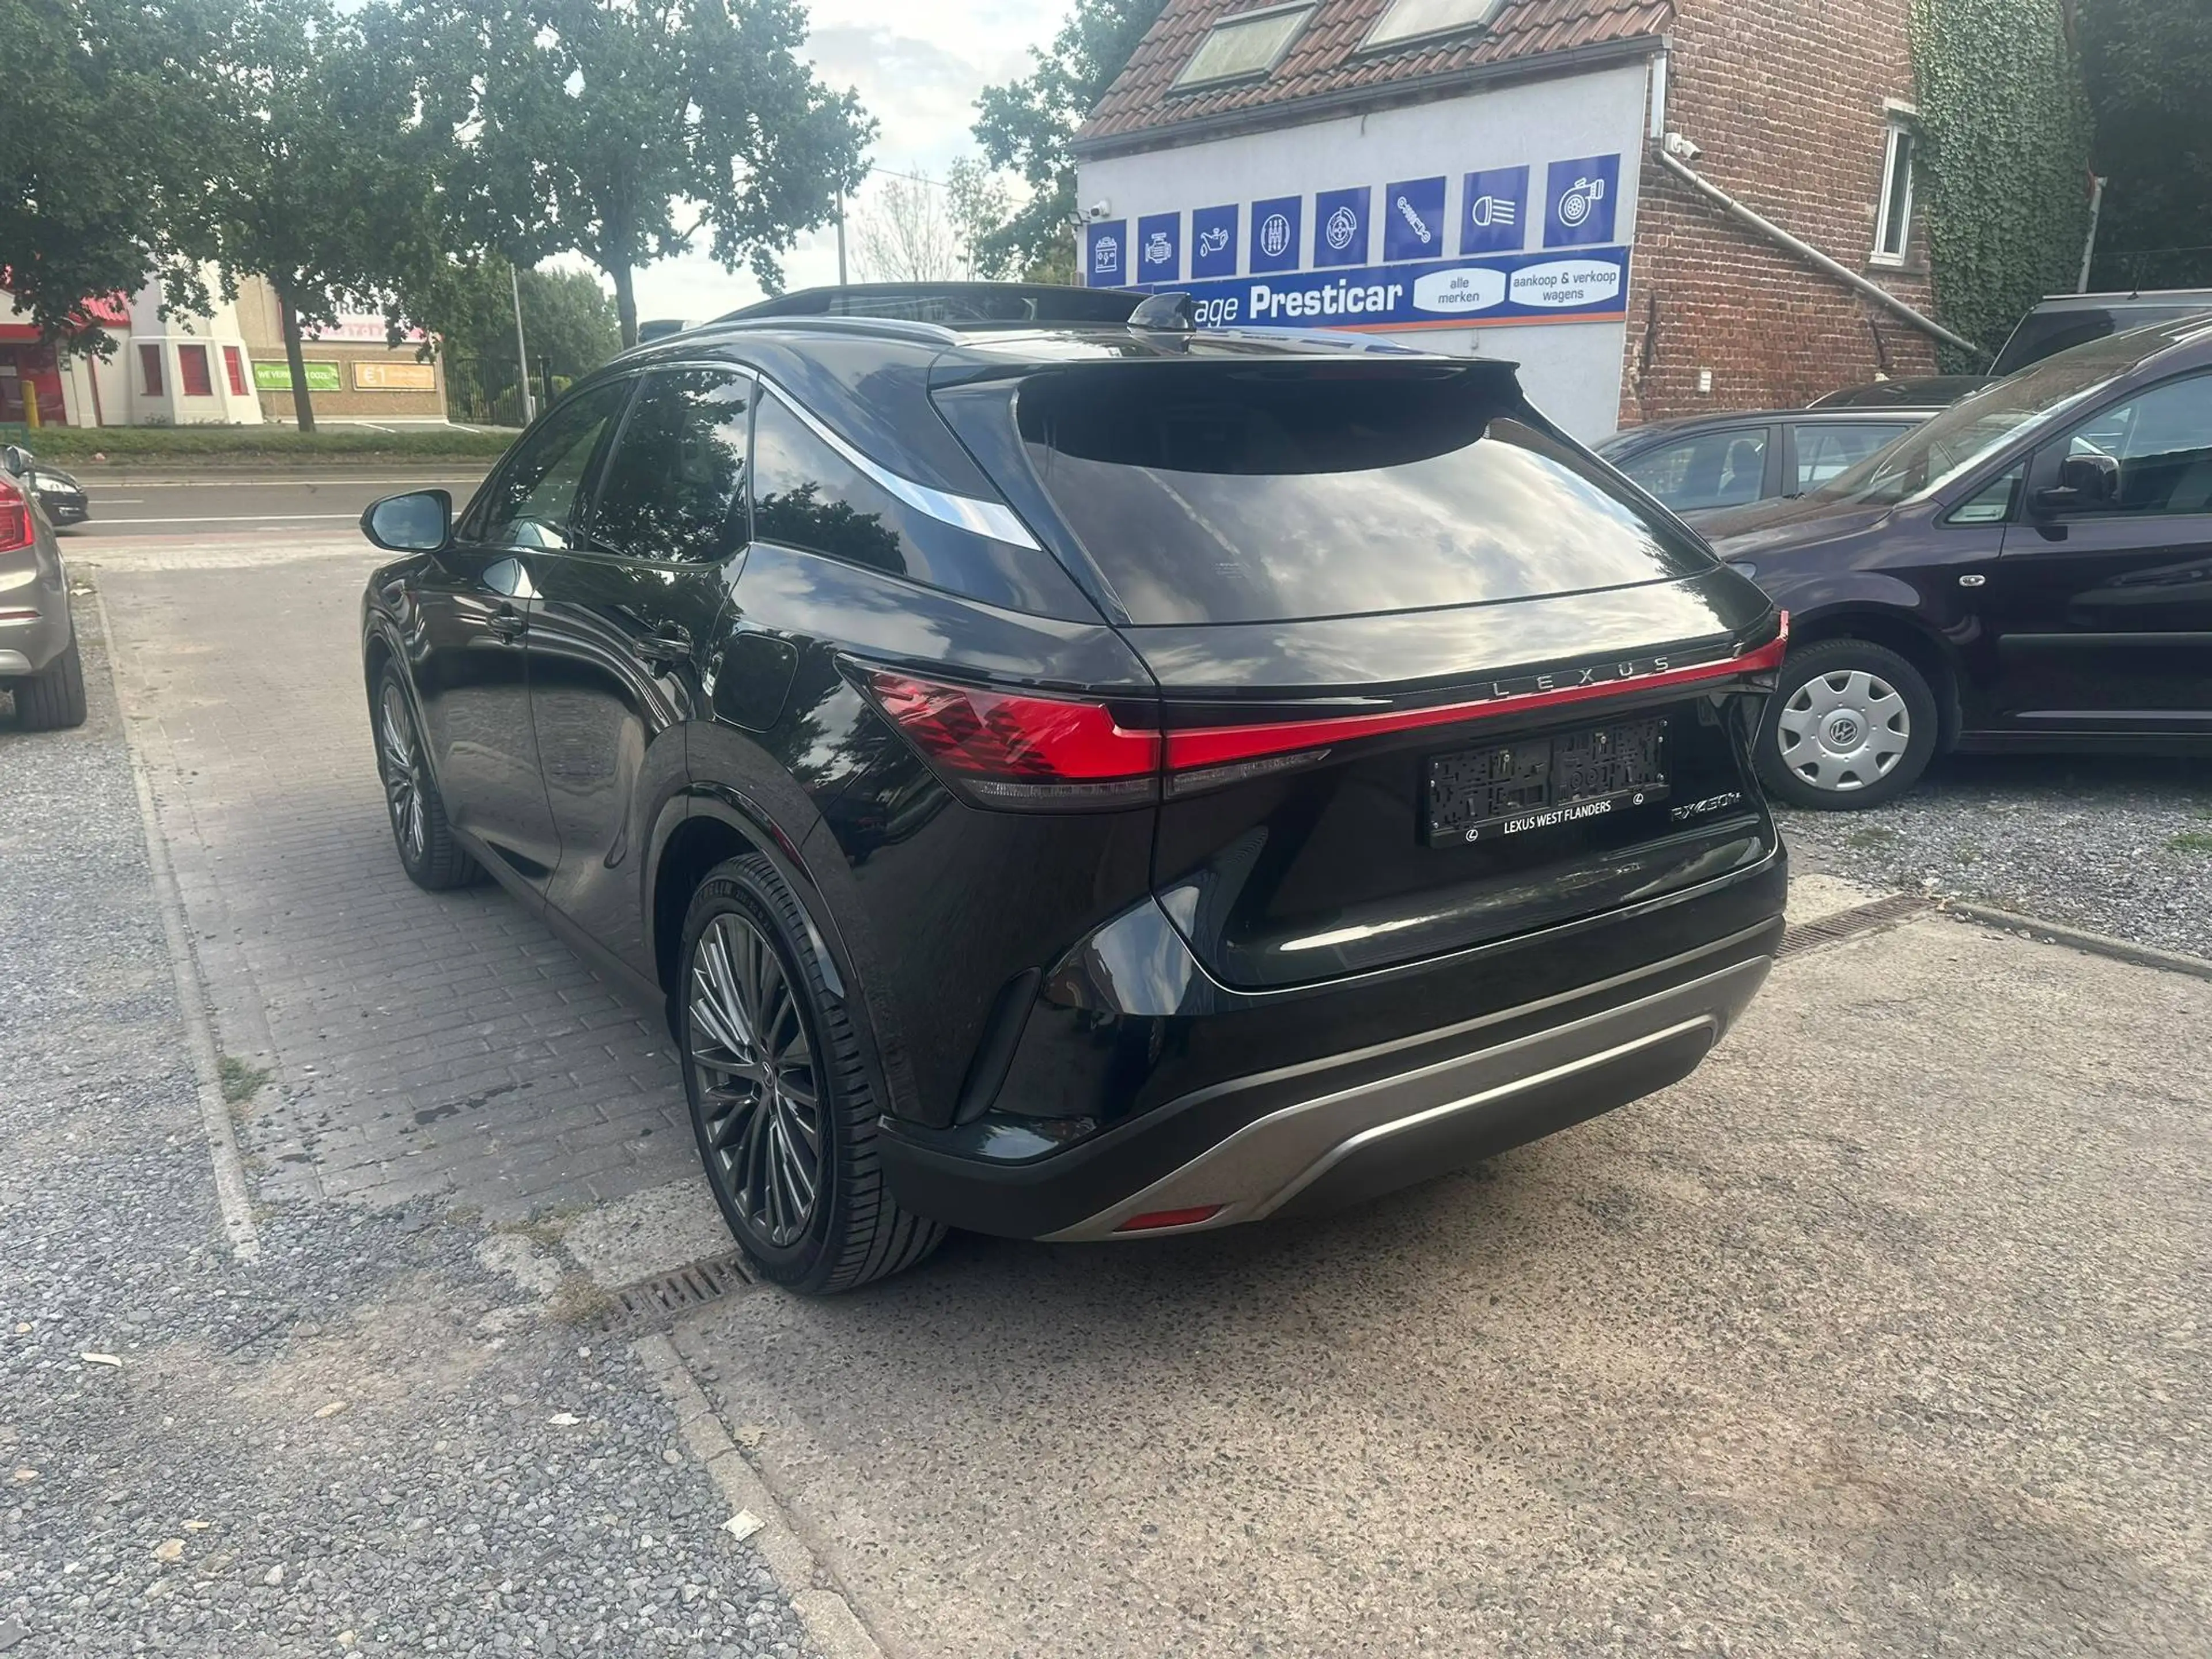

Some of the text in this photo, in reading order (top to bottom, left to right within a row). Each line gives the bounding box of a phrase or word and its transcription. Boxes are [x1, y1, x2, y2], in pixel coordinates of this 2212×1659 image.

[1450, 276, 1469, 289] alle
[1513, 270, 1616, 287] aankoop & verkoop
[1249, 278, 1402, 319] Presticar
[1438, 291, 1479, 303] merken
[1543, 290, 1584, 303] wagens
[1493, 657, 1669, 696] LEXUS
[1504, 800, 1611, 834] LEXUS WEST FLANDERS
